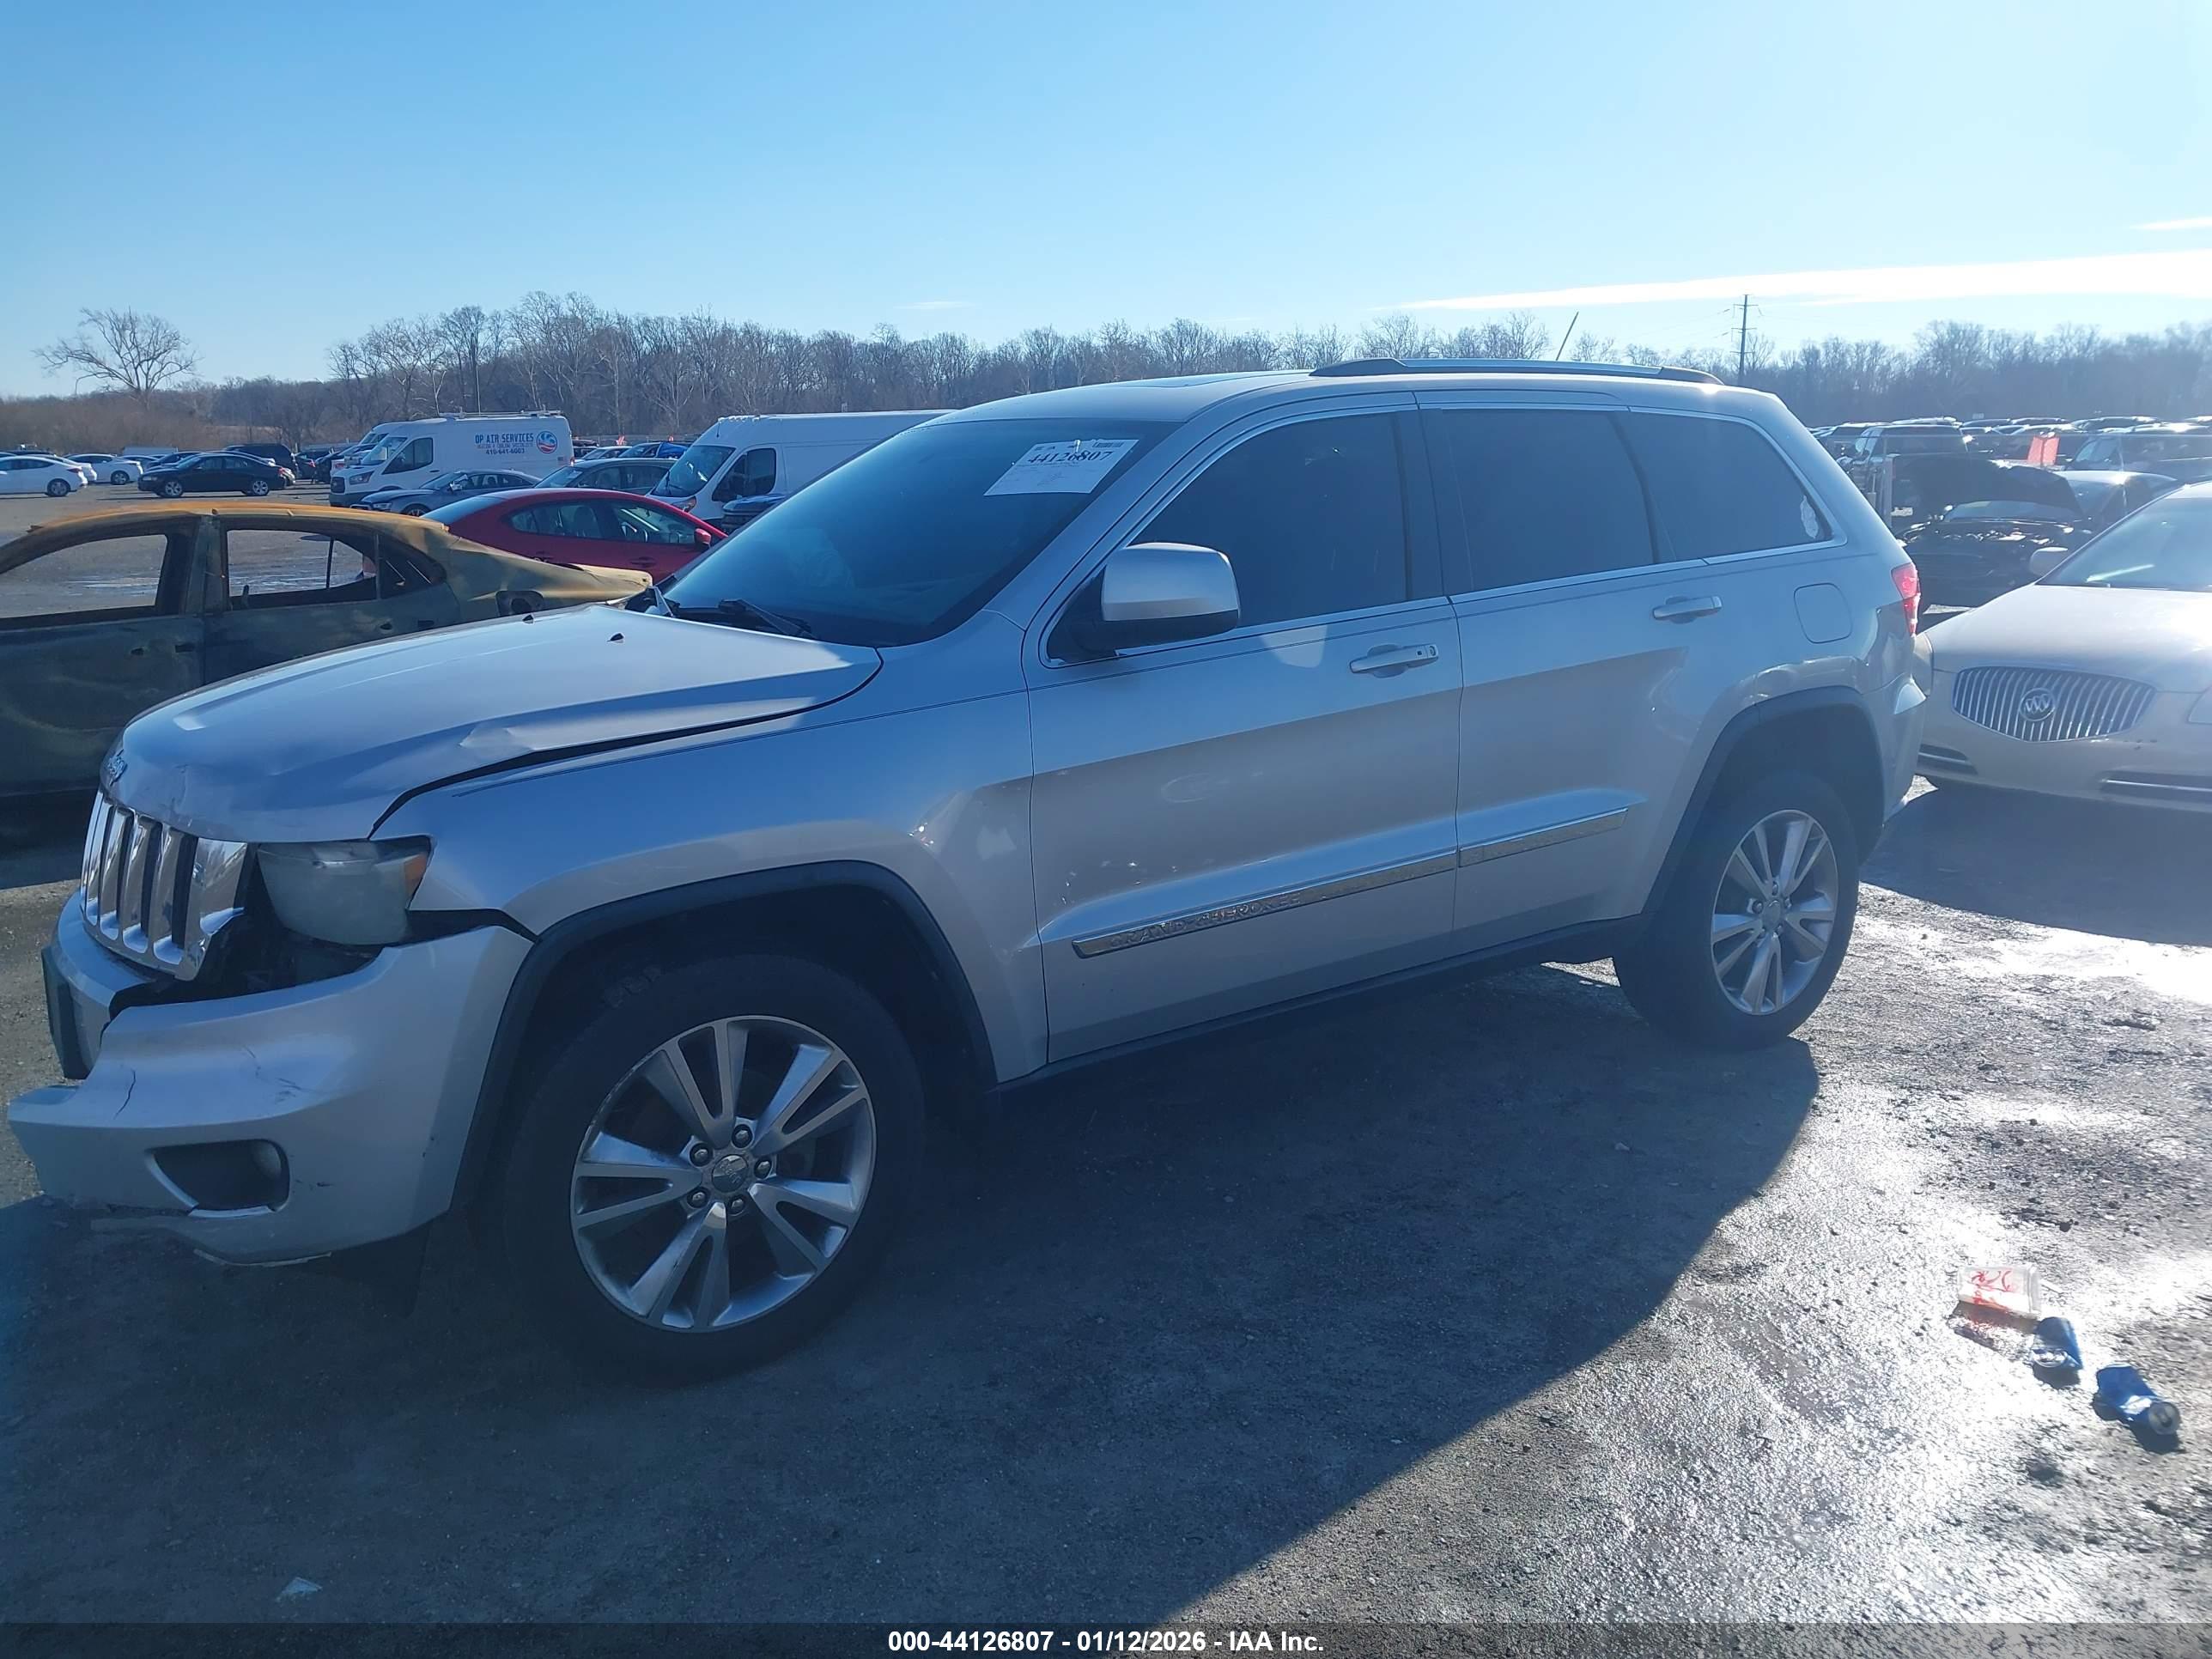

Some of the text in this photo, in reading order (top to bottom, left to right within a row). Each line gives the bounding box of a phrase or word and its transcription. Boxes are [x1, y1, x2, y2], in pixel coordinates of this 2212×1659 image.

[475, 433, 534, 444] OP AIR SERVICES
[1028, 451, 1113, 463] 44126807
